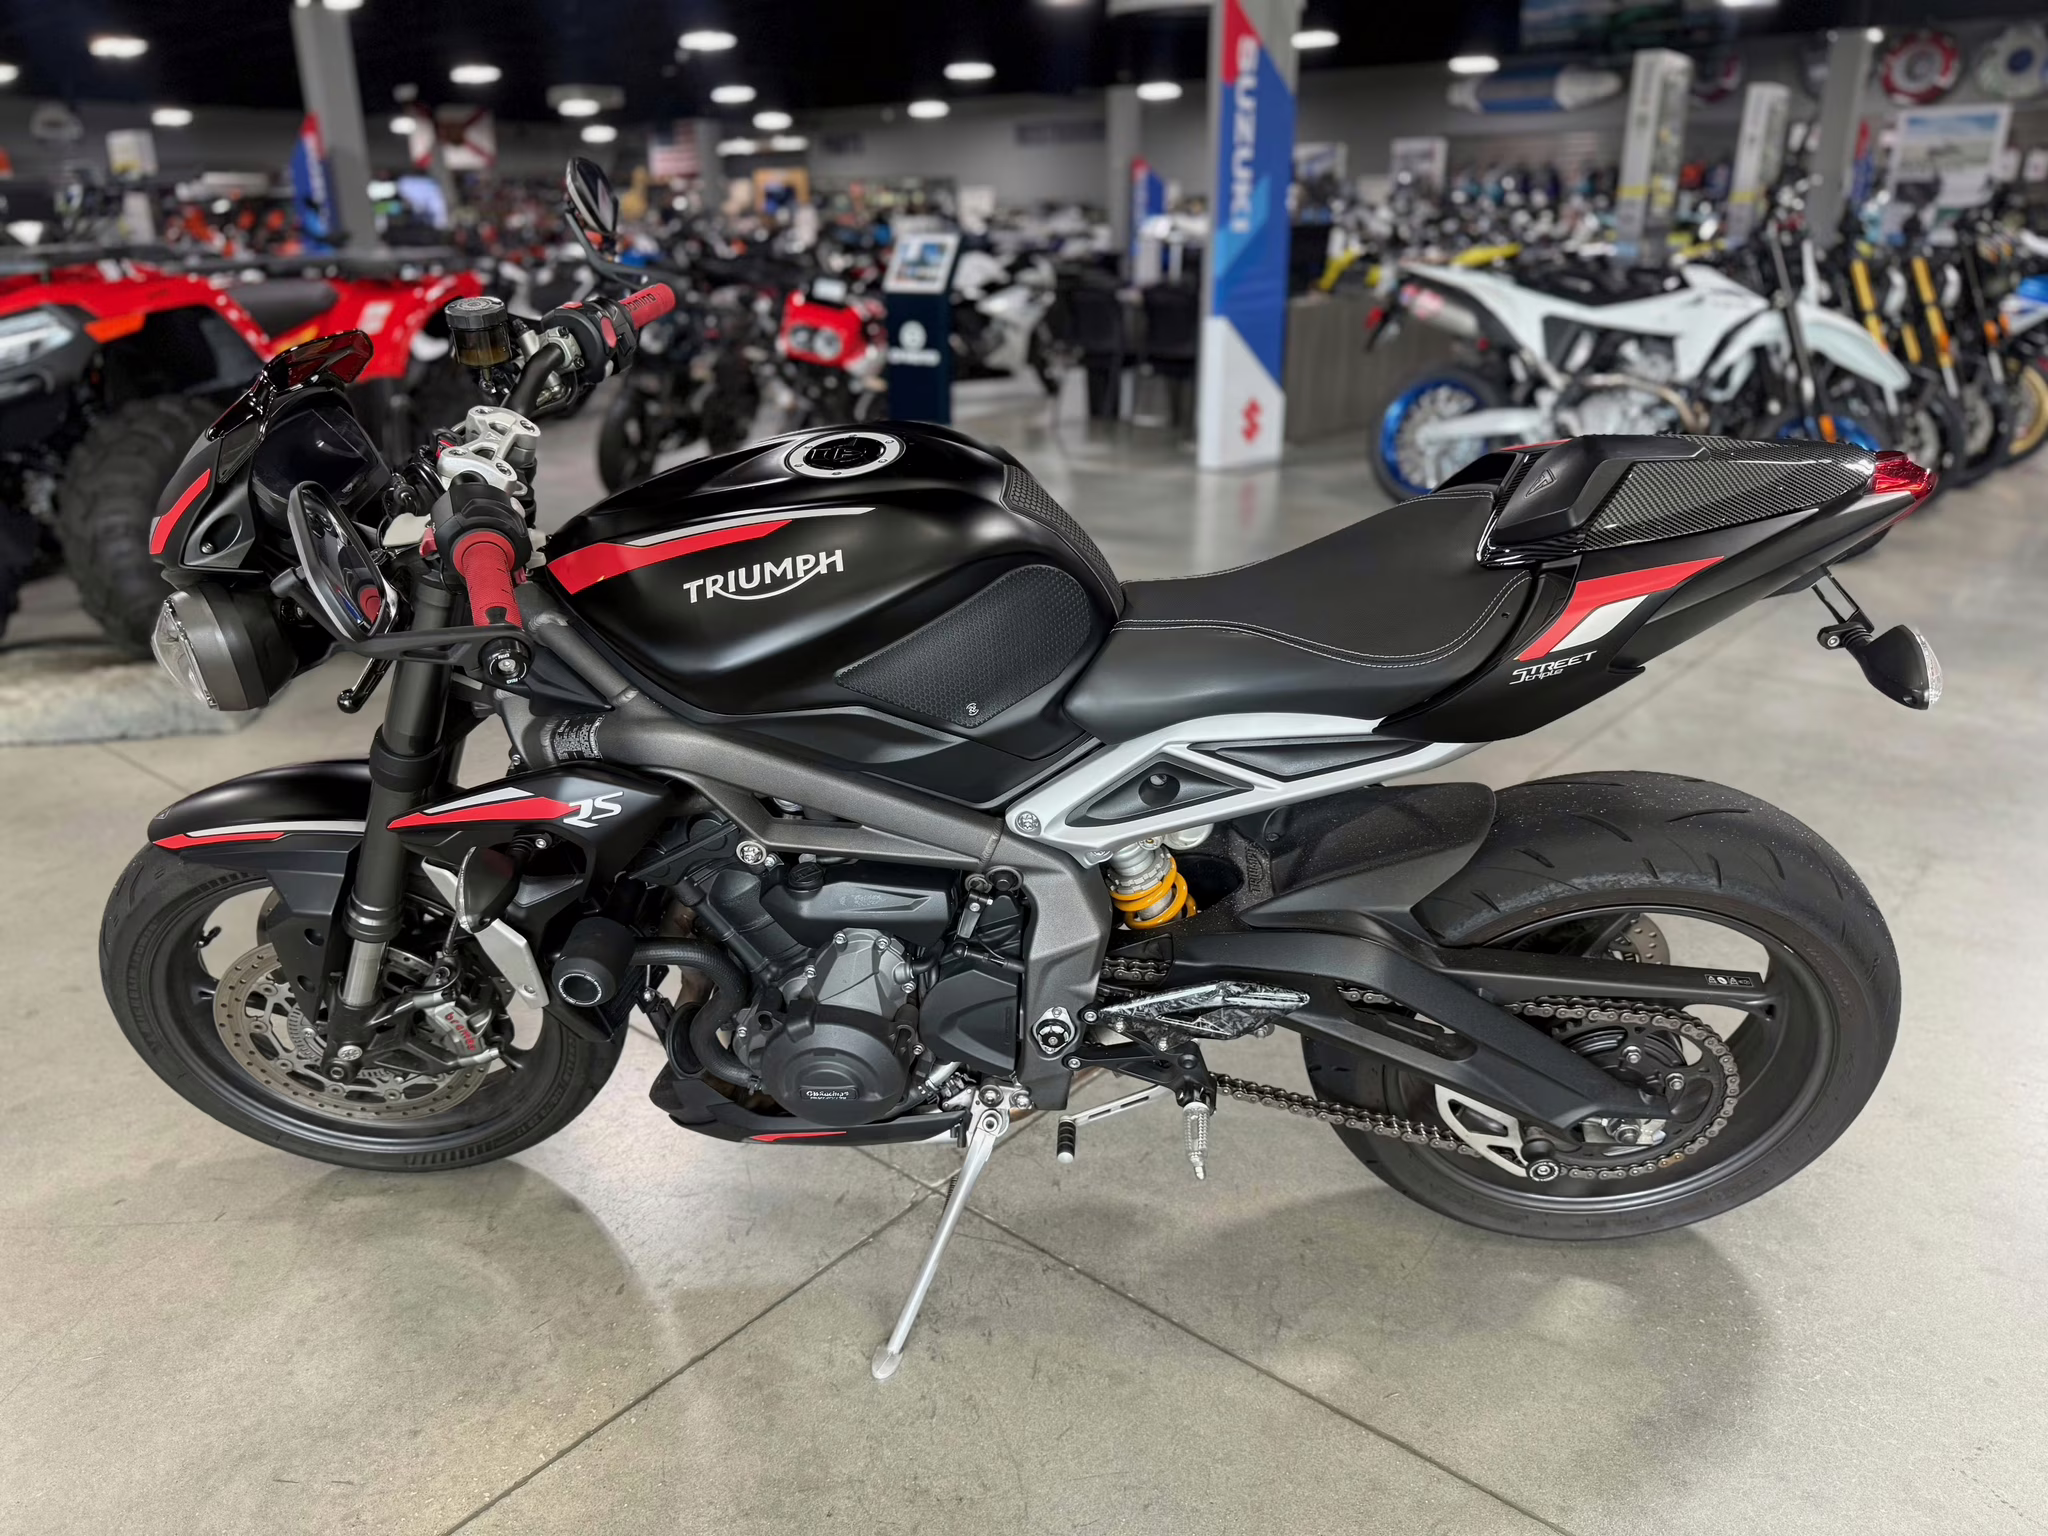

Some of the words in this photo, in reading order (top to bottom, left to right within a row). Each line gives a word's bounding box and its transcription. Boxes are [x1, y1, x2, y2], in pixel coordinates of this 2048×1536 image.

[1230, 34, 1260, 234] SUZUKI
[683, 549, 844, 604] TRIUMPH
[1509, 650, 1598, 685] STREET
[563, 791, 624, 828] RS
